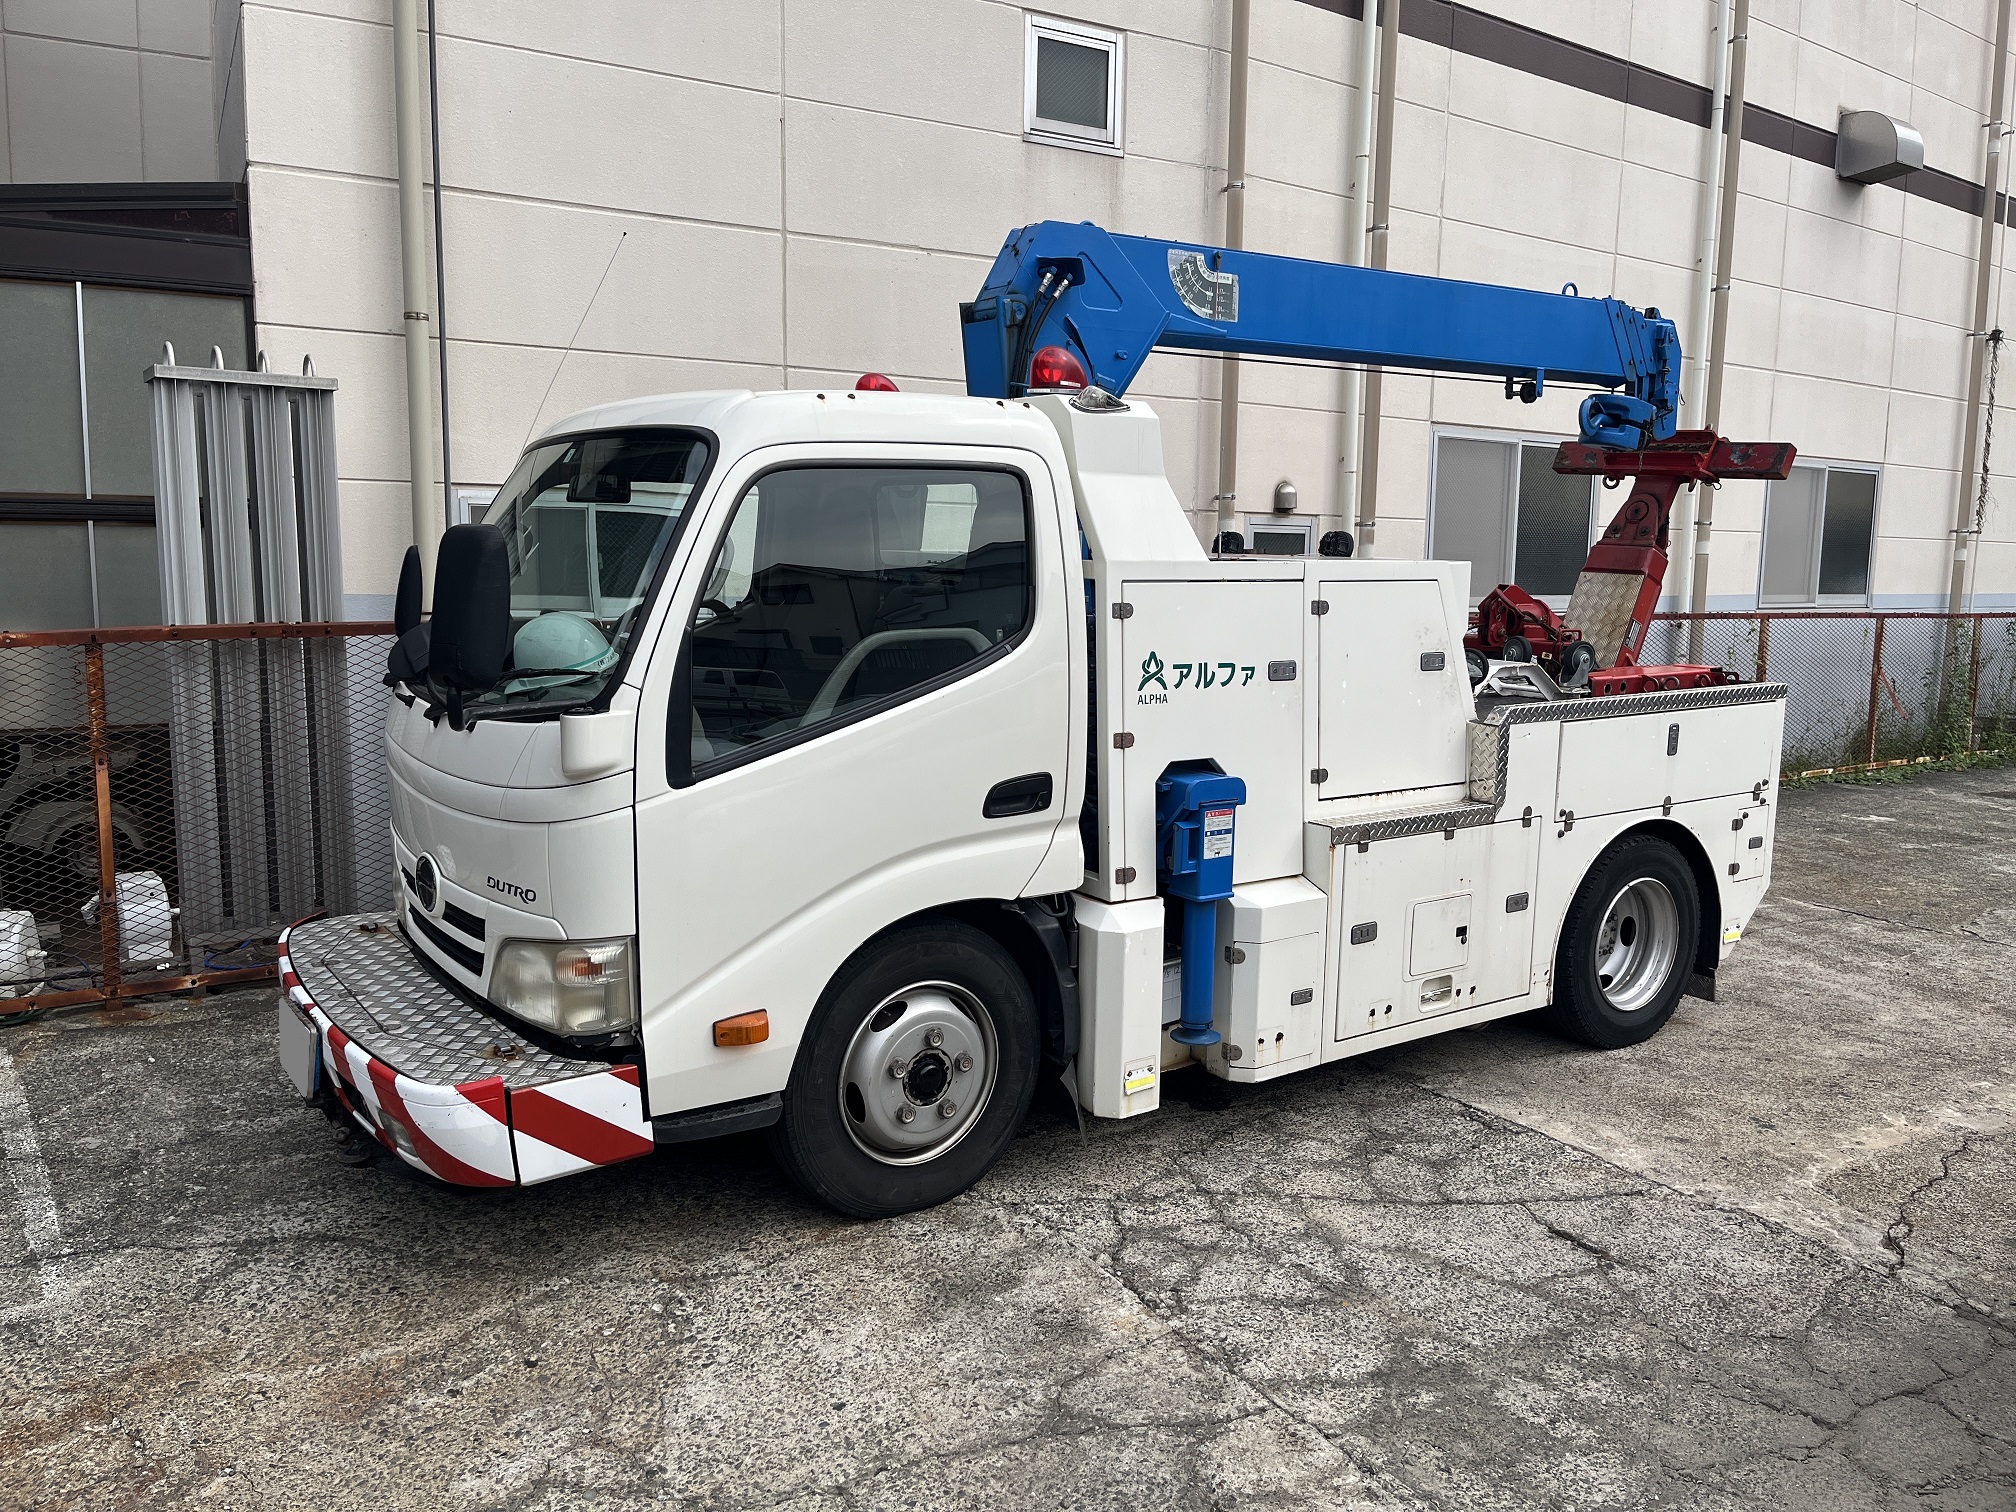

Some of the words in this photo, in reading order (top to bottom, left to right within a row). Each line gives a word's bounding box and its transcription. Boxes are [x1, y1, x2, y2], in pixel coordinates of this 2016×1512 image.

[1172, 661, 1256, 690] アルファ
[1137, 693, 1168, 705] ALPHA
[486, 875, 537, 905] DUTRO
